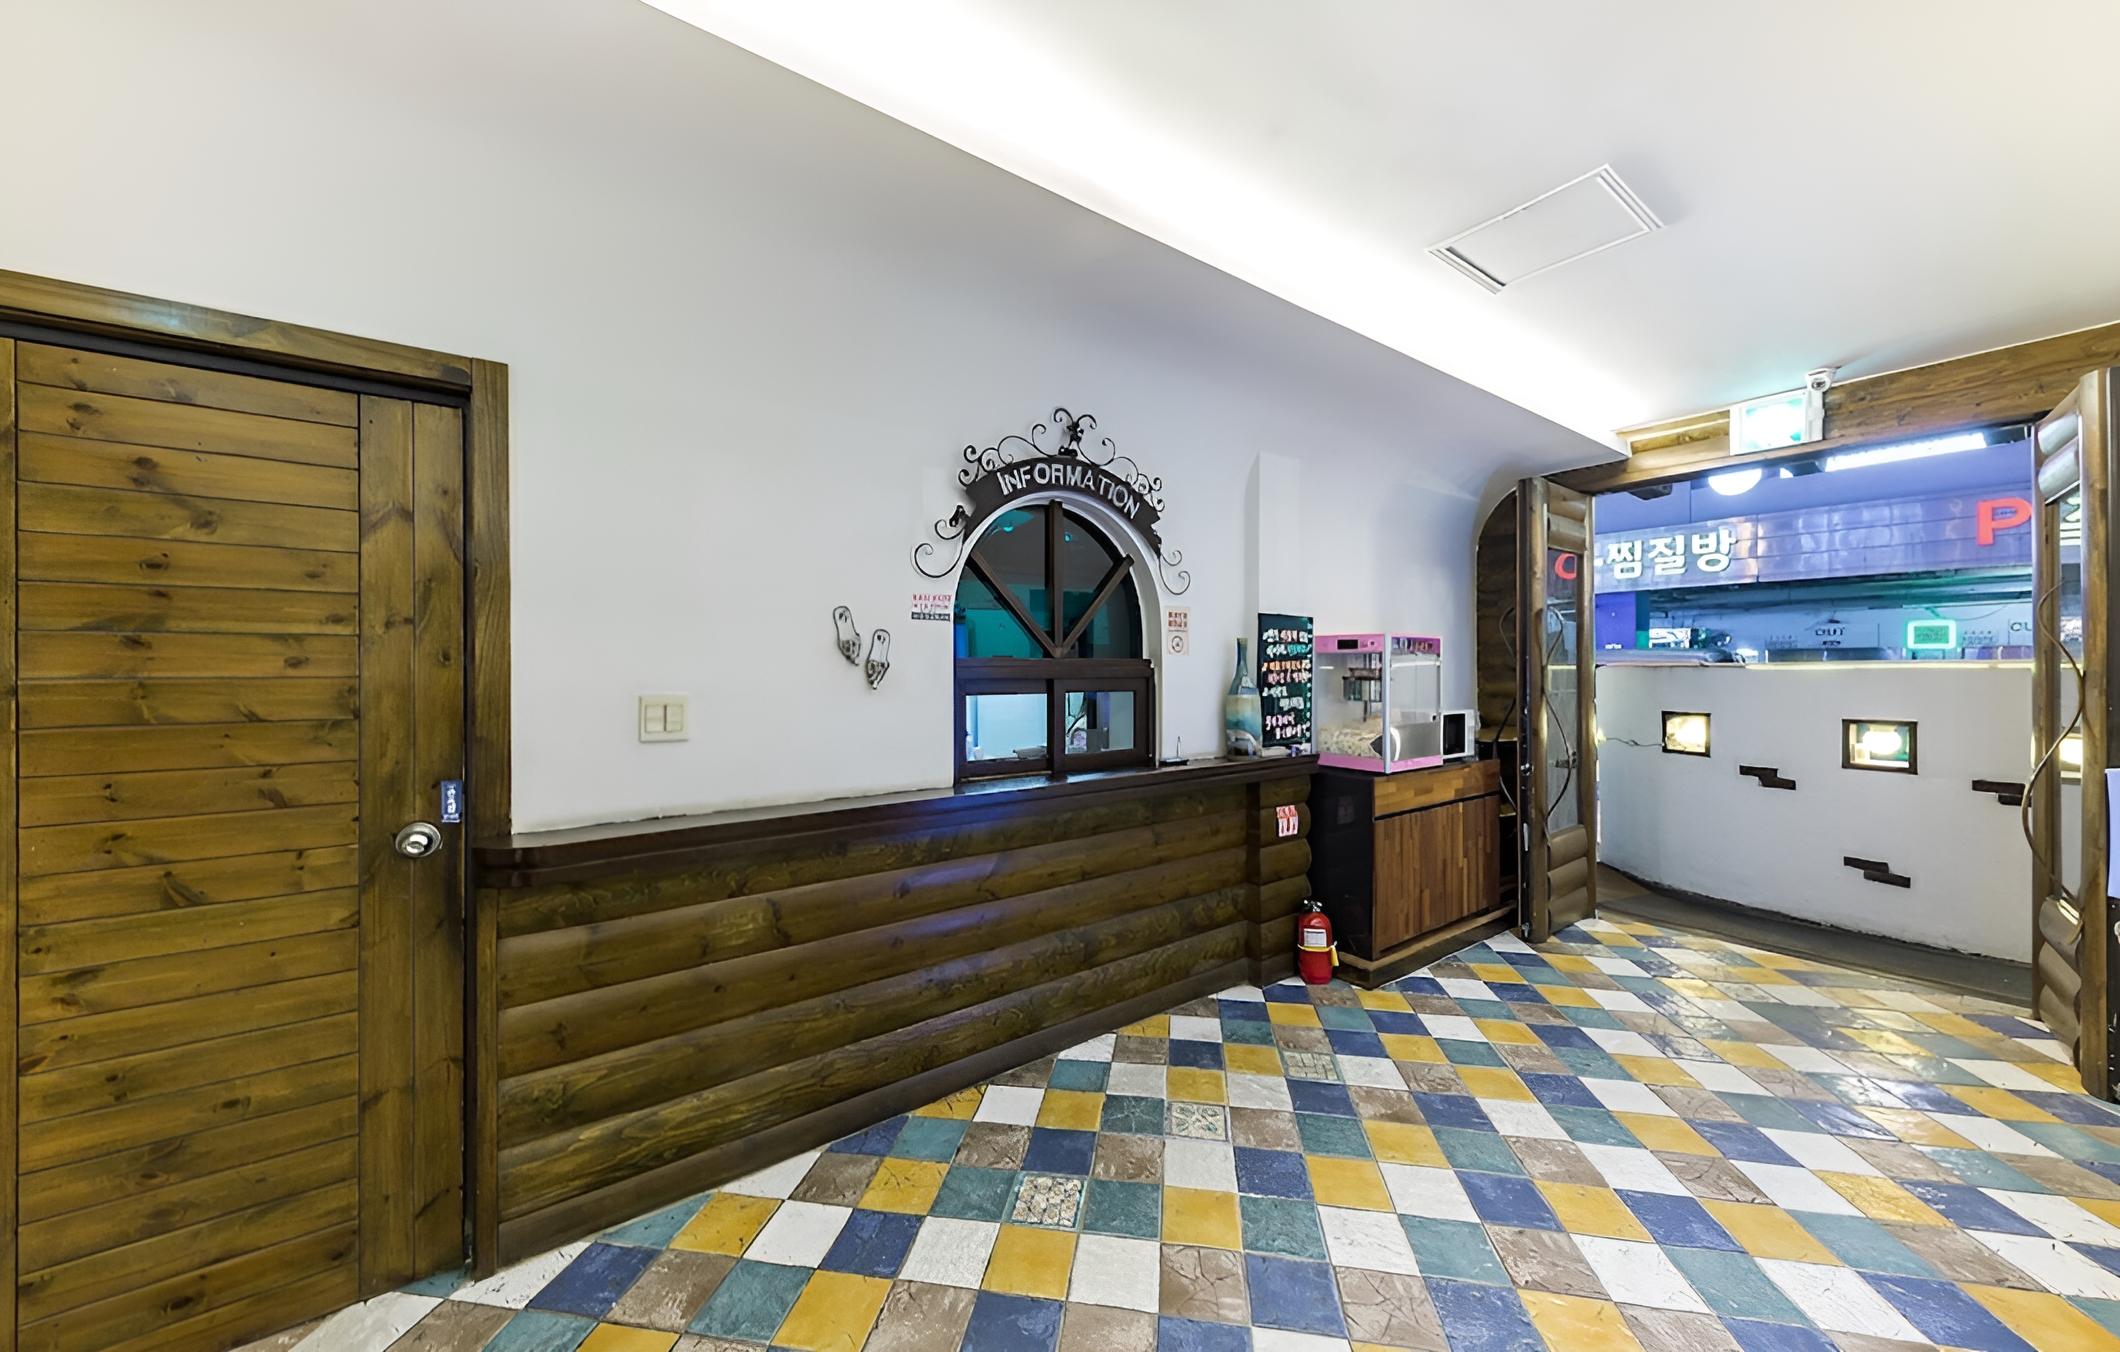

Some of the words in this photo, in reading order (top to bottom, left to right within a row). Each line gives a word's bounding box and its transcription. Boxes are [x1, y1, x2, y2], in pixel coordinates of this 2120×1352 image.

[996, 463, 1140, 520] INFORMATION
[1976, 496, 2033, 546] P
[1595, 528, 1737, 580] 찜질방
